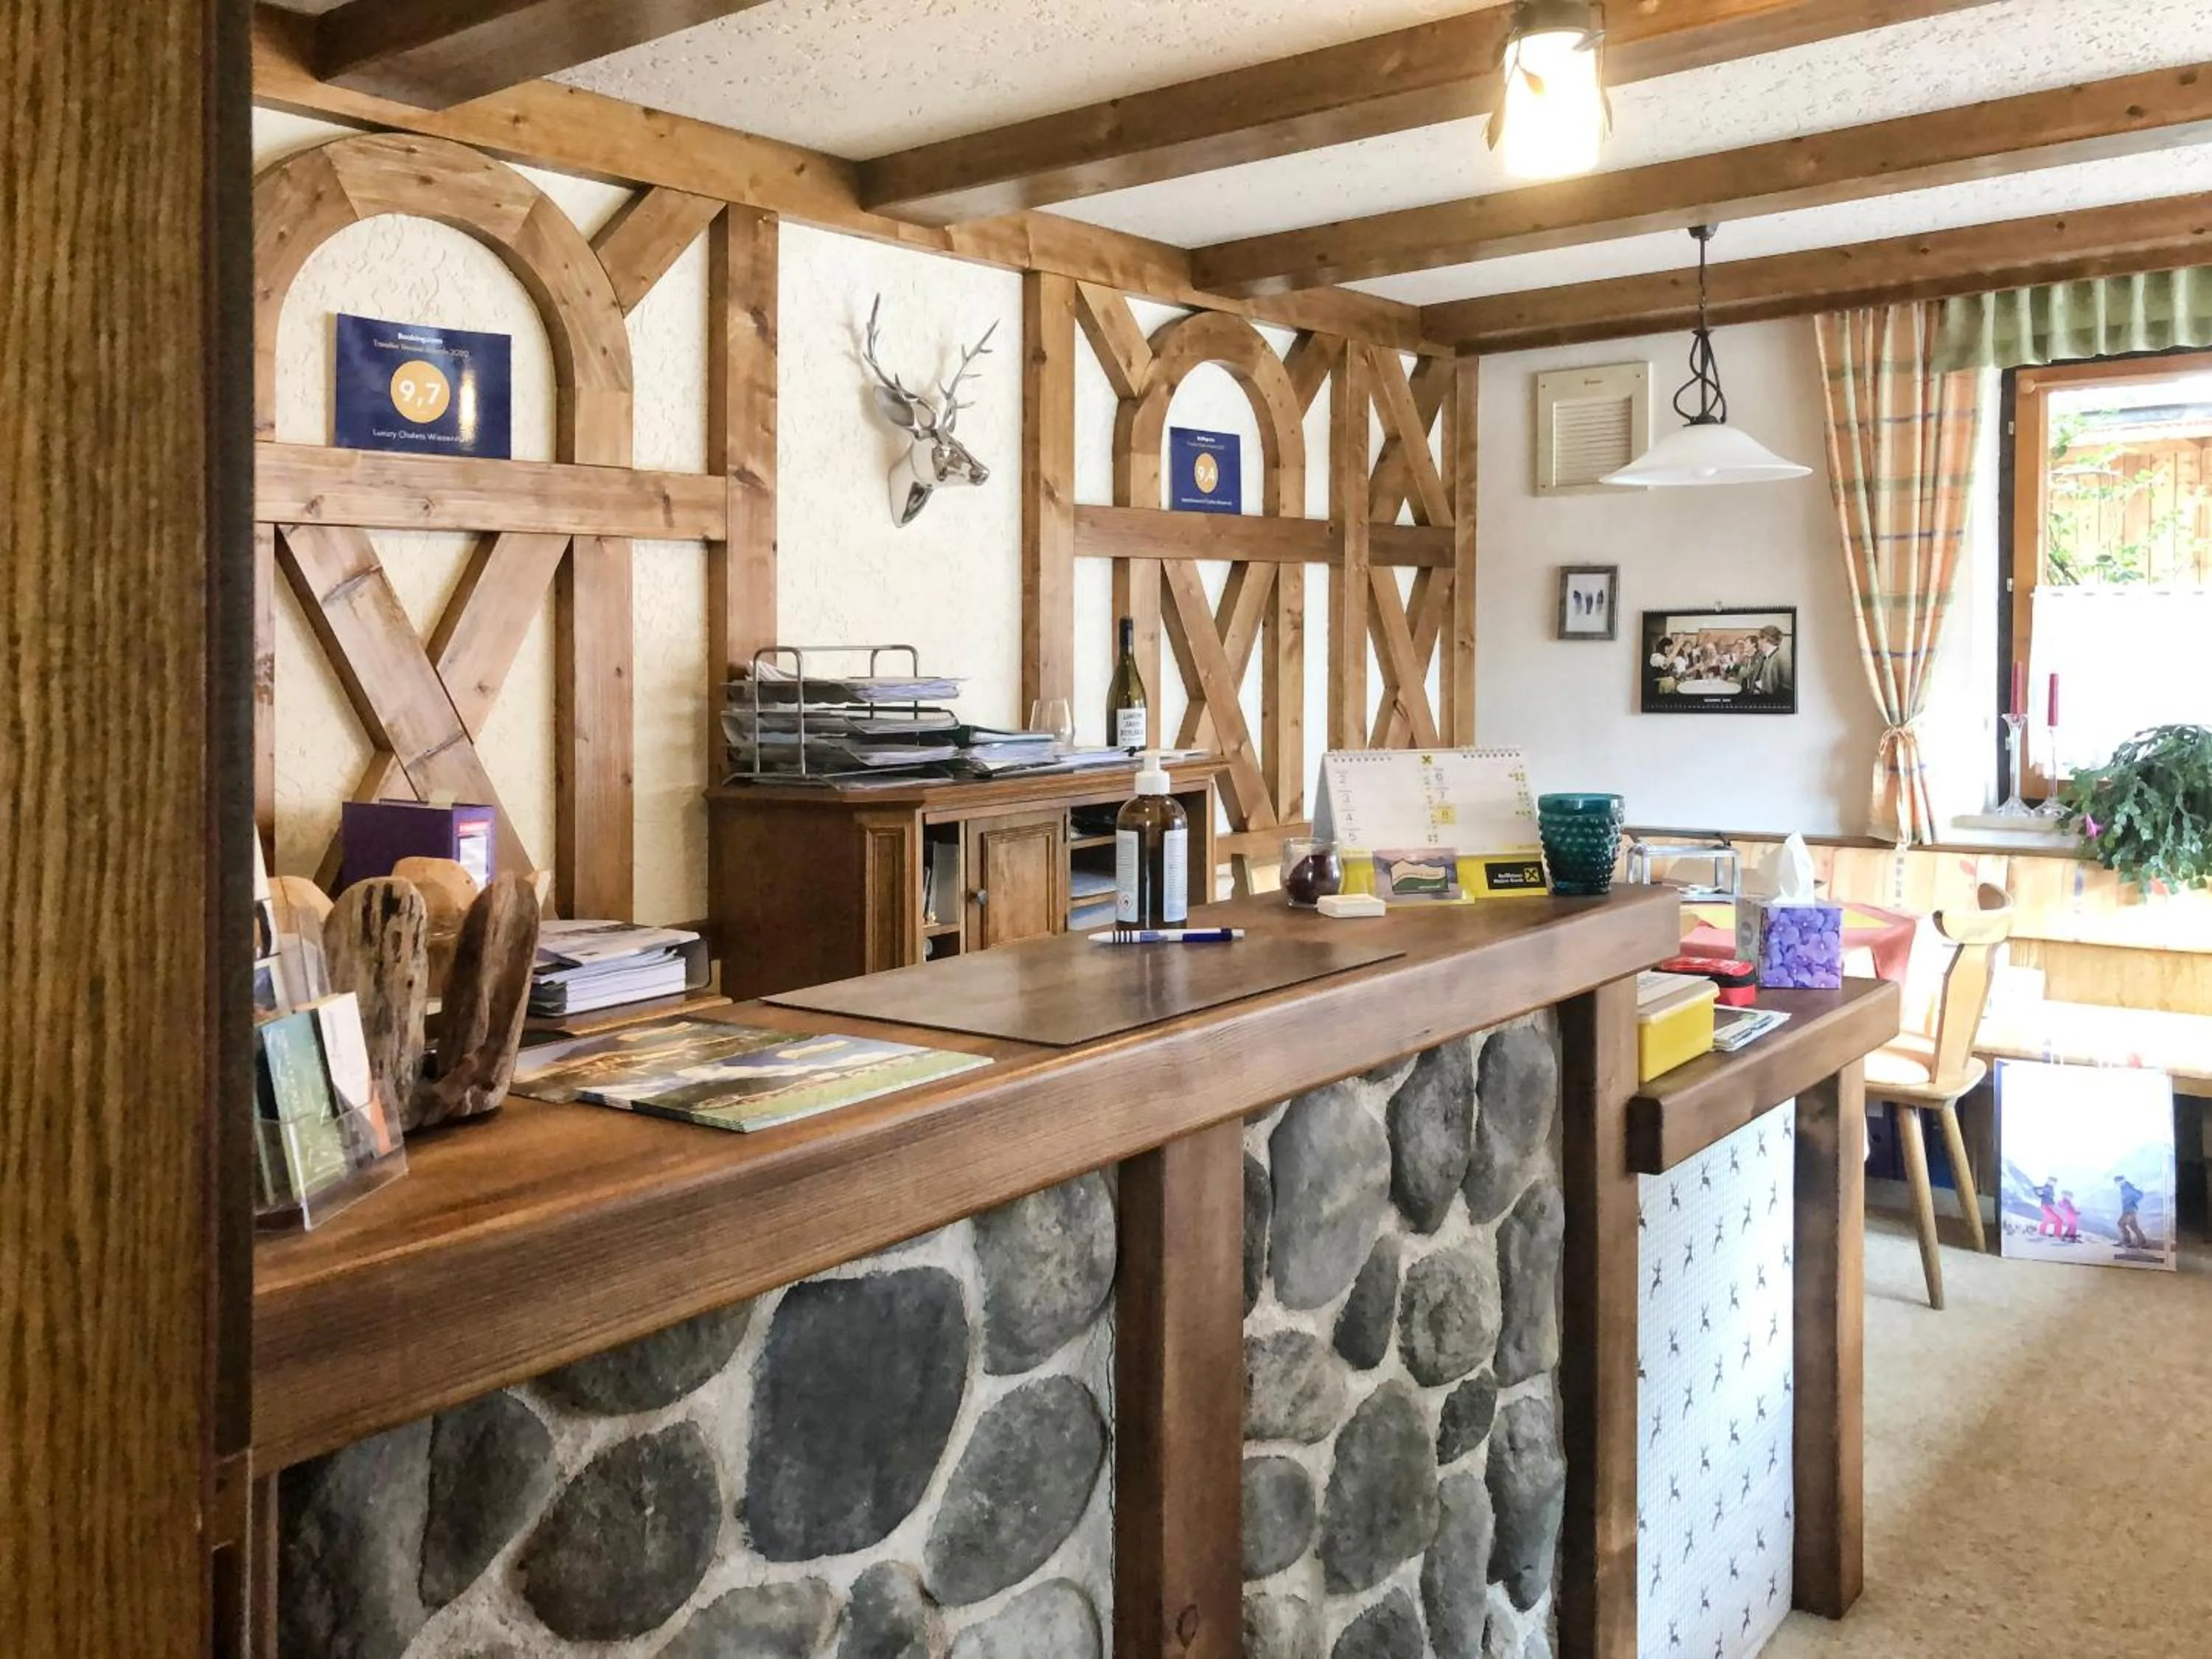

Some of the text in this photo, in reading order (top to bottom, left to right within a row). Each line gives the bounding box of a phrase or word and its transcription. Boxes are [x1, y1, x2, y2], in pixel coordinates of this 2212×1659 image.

[399, 379, 442, 409] 9,7
[372, 428, 397, 439] Luxury
[398, 430, 426, 440] Chalets
